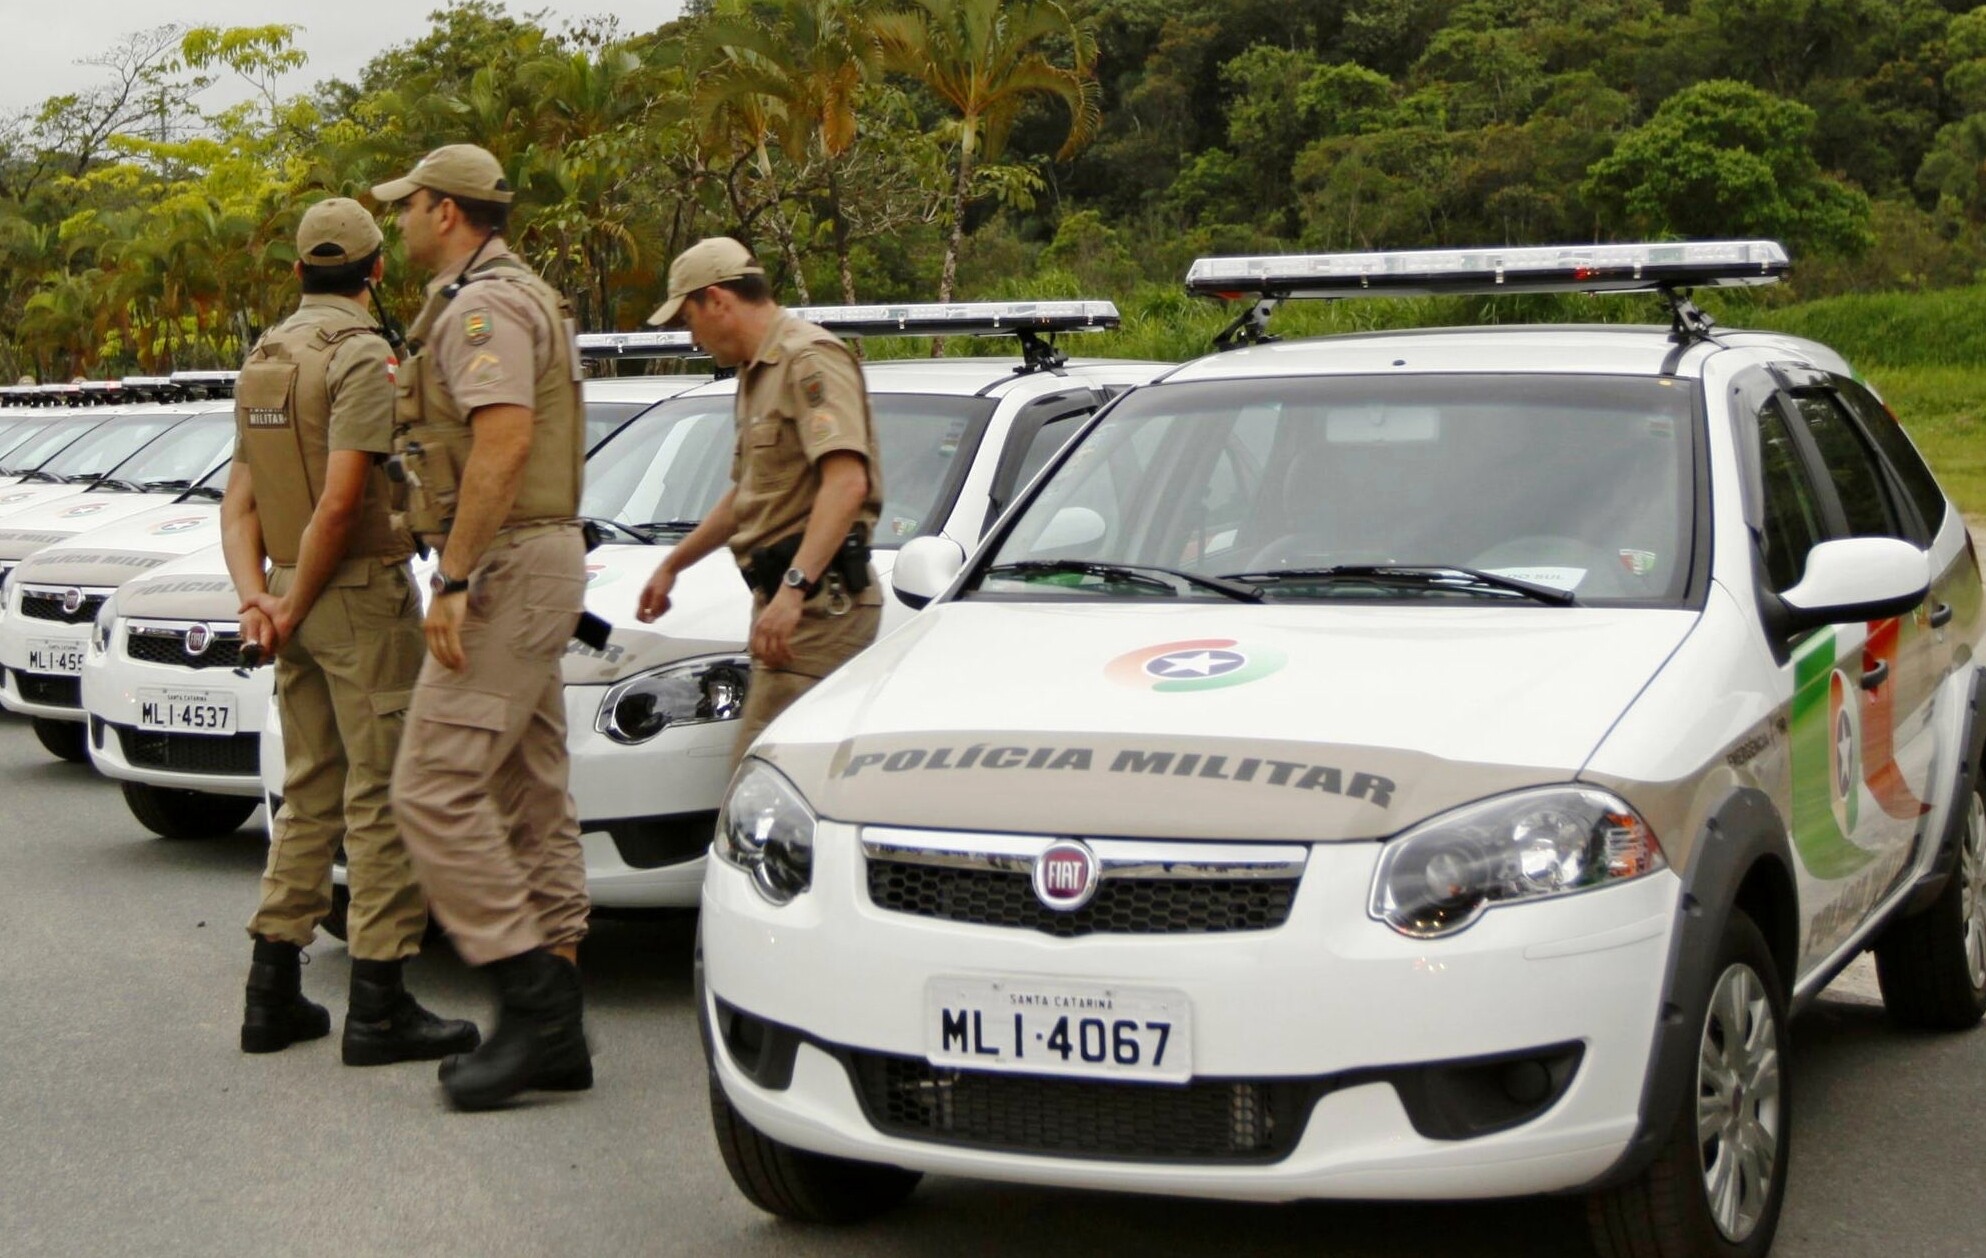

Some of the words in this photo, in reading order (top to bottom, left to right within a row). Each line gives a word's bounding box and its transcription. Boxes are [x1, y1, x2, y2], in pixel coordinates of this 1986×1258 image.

[842, 743, 1093, 779] POLÍCIA
[1108, 749, 1396, 810] MILITAR
[1047, 860, 1083, 890] FIAT
[1010, 994, 1049, 1006] SANTA
[1053, 996, 1114, 1011] CATARINA
